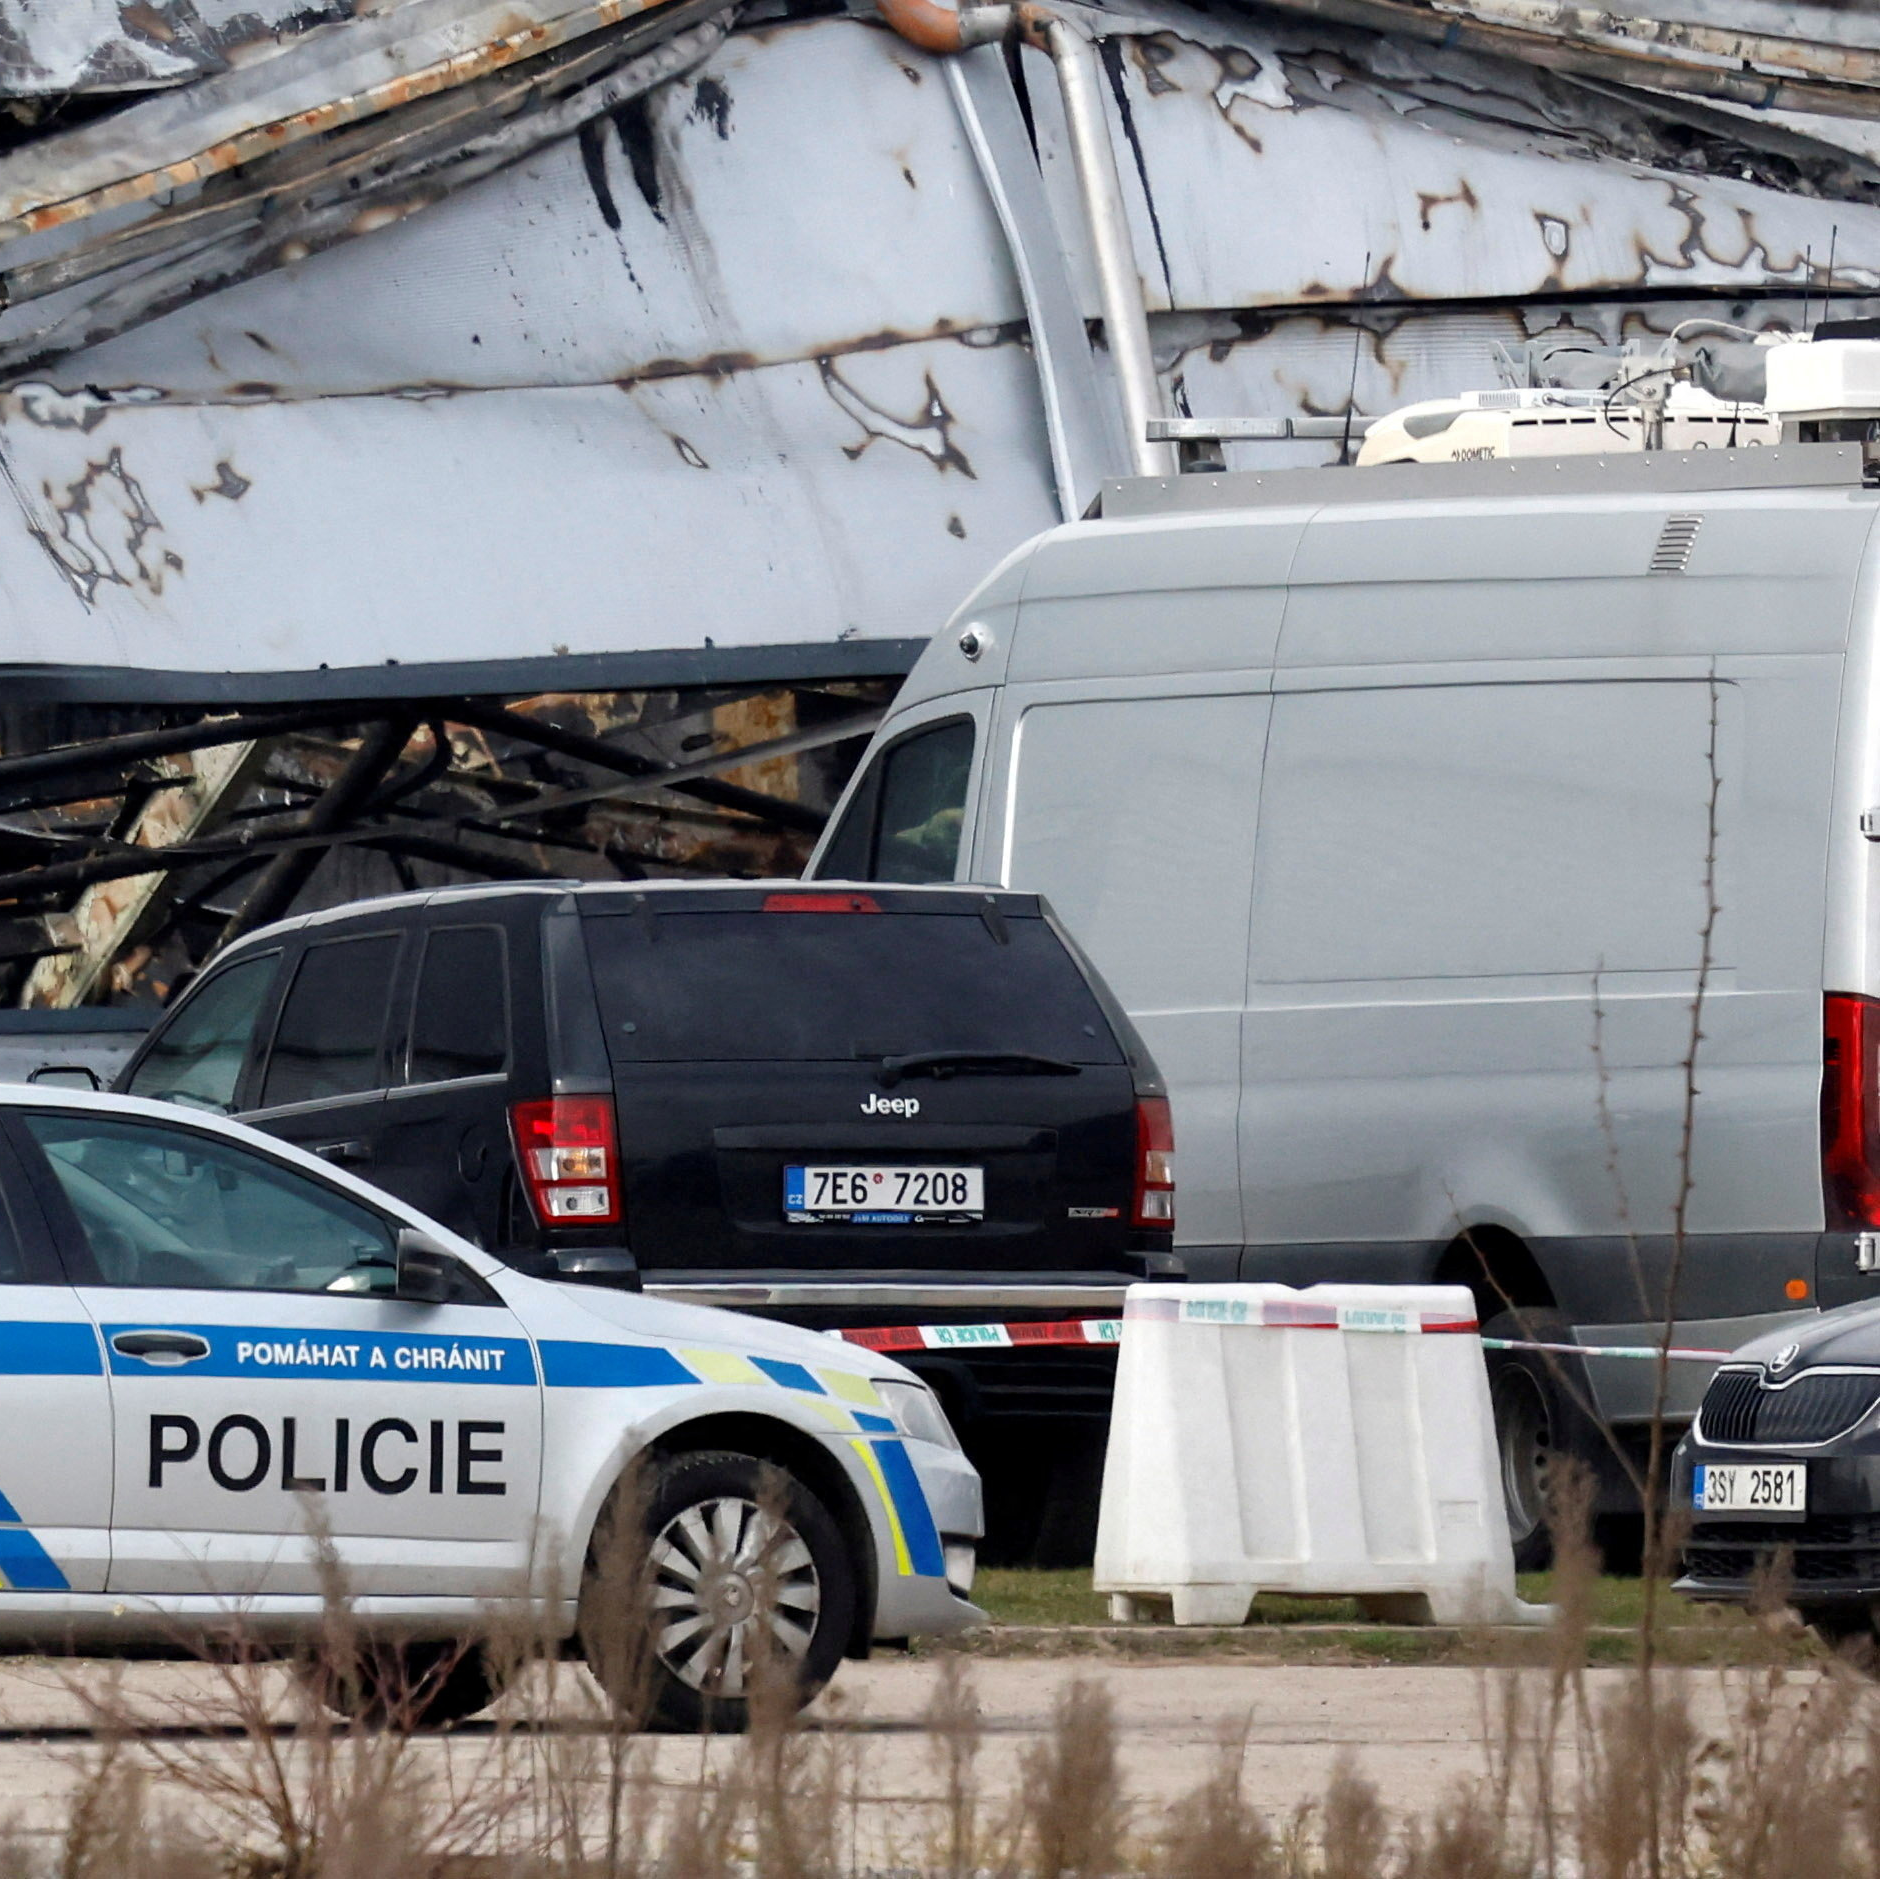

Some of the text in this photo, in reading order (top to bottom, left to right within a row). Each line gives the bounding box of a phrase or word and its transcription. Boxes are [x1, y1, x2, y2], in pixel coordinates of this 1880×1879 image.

[860, 1093, 920, 1118] Jeep
[813, 1172, 968, 1205] 7E6 7208
[237, 1339, 506, 1372] POMÁHAT A CHRÁNIT
[148, 1414, 506, 1495] POLICIE
[1708, 1470, 1736, 1504] 3SY
[1750, 1470, 1795, 1505] 2581
